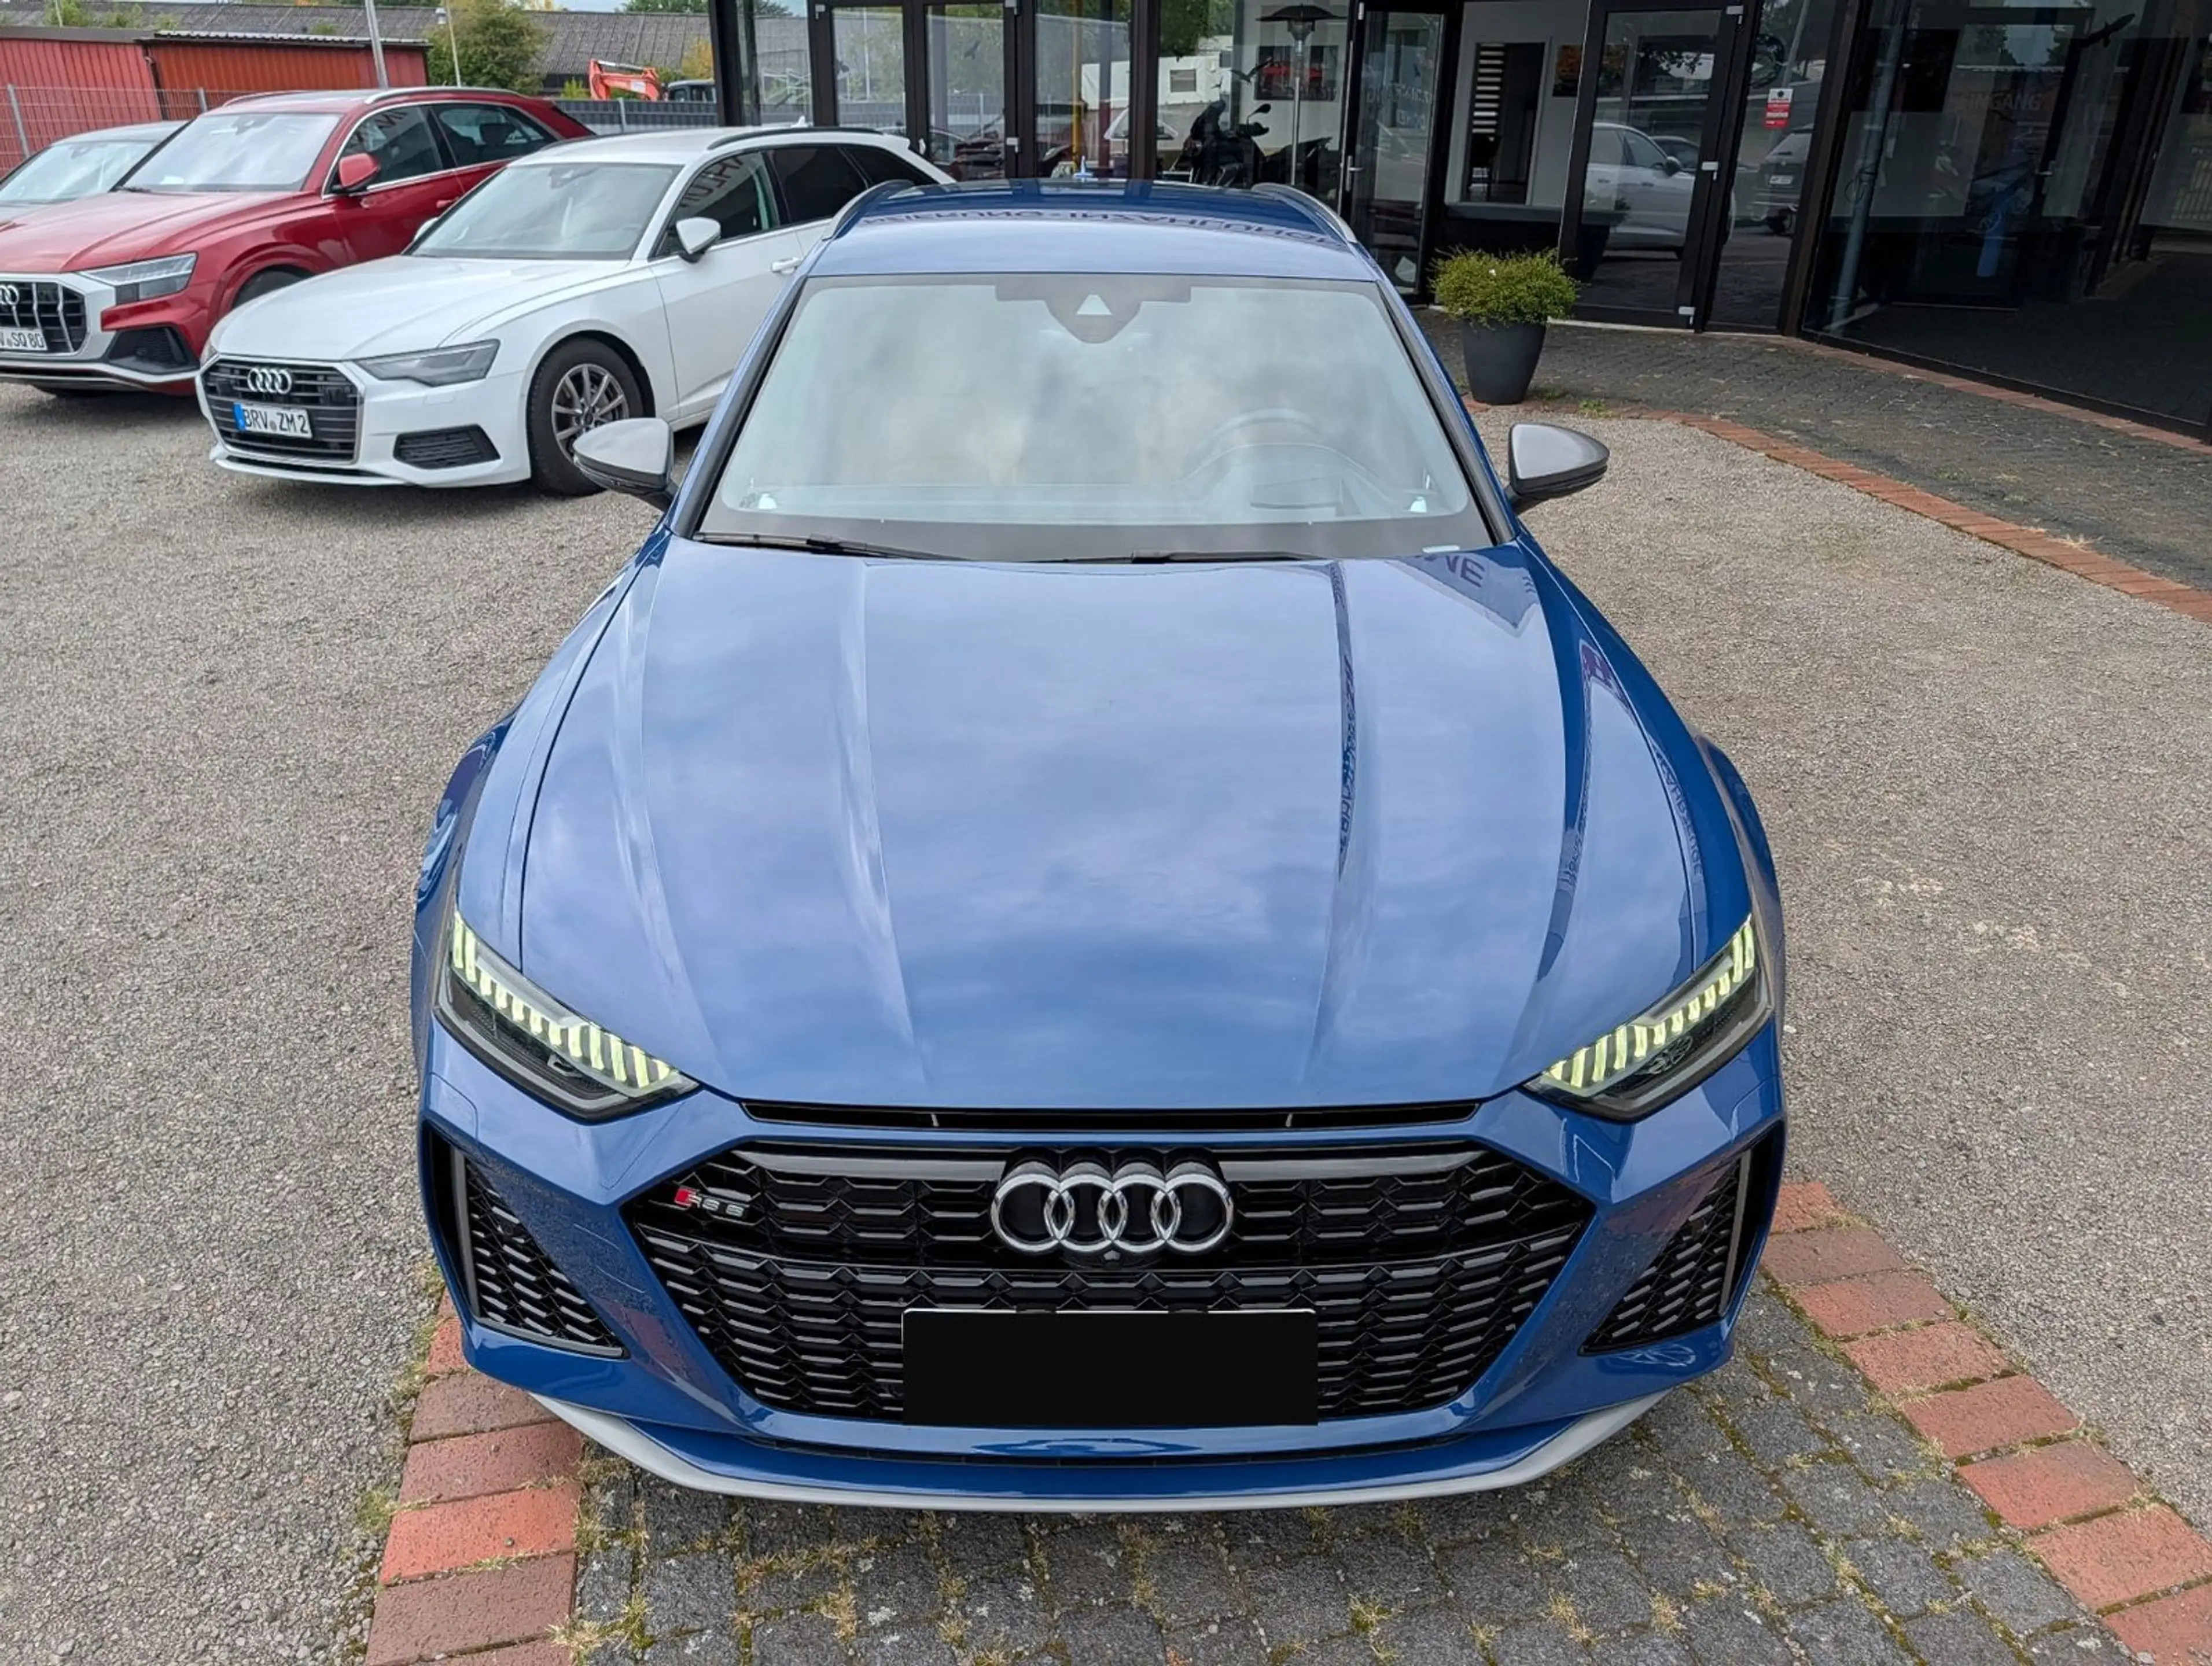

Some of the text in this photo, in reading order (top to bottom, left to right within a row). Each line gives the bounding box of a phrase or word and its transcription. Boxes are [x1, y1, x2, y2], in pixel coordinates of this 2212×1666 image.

[242, 408, 308, 434] BRV ZM 2
